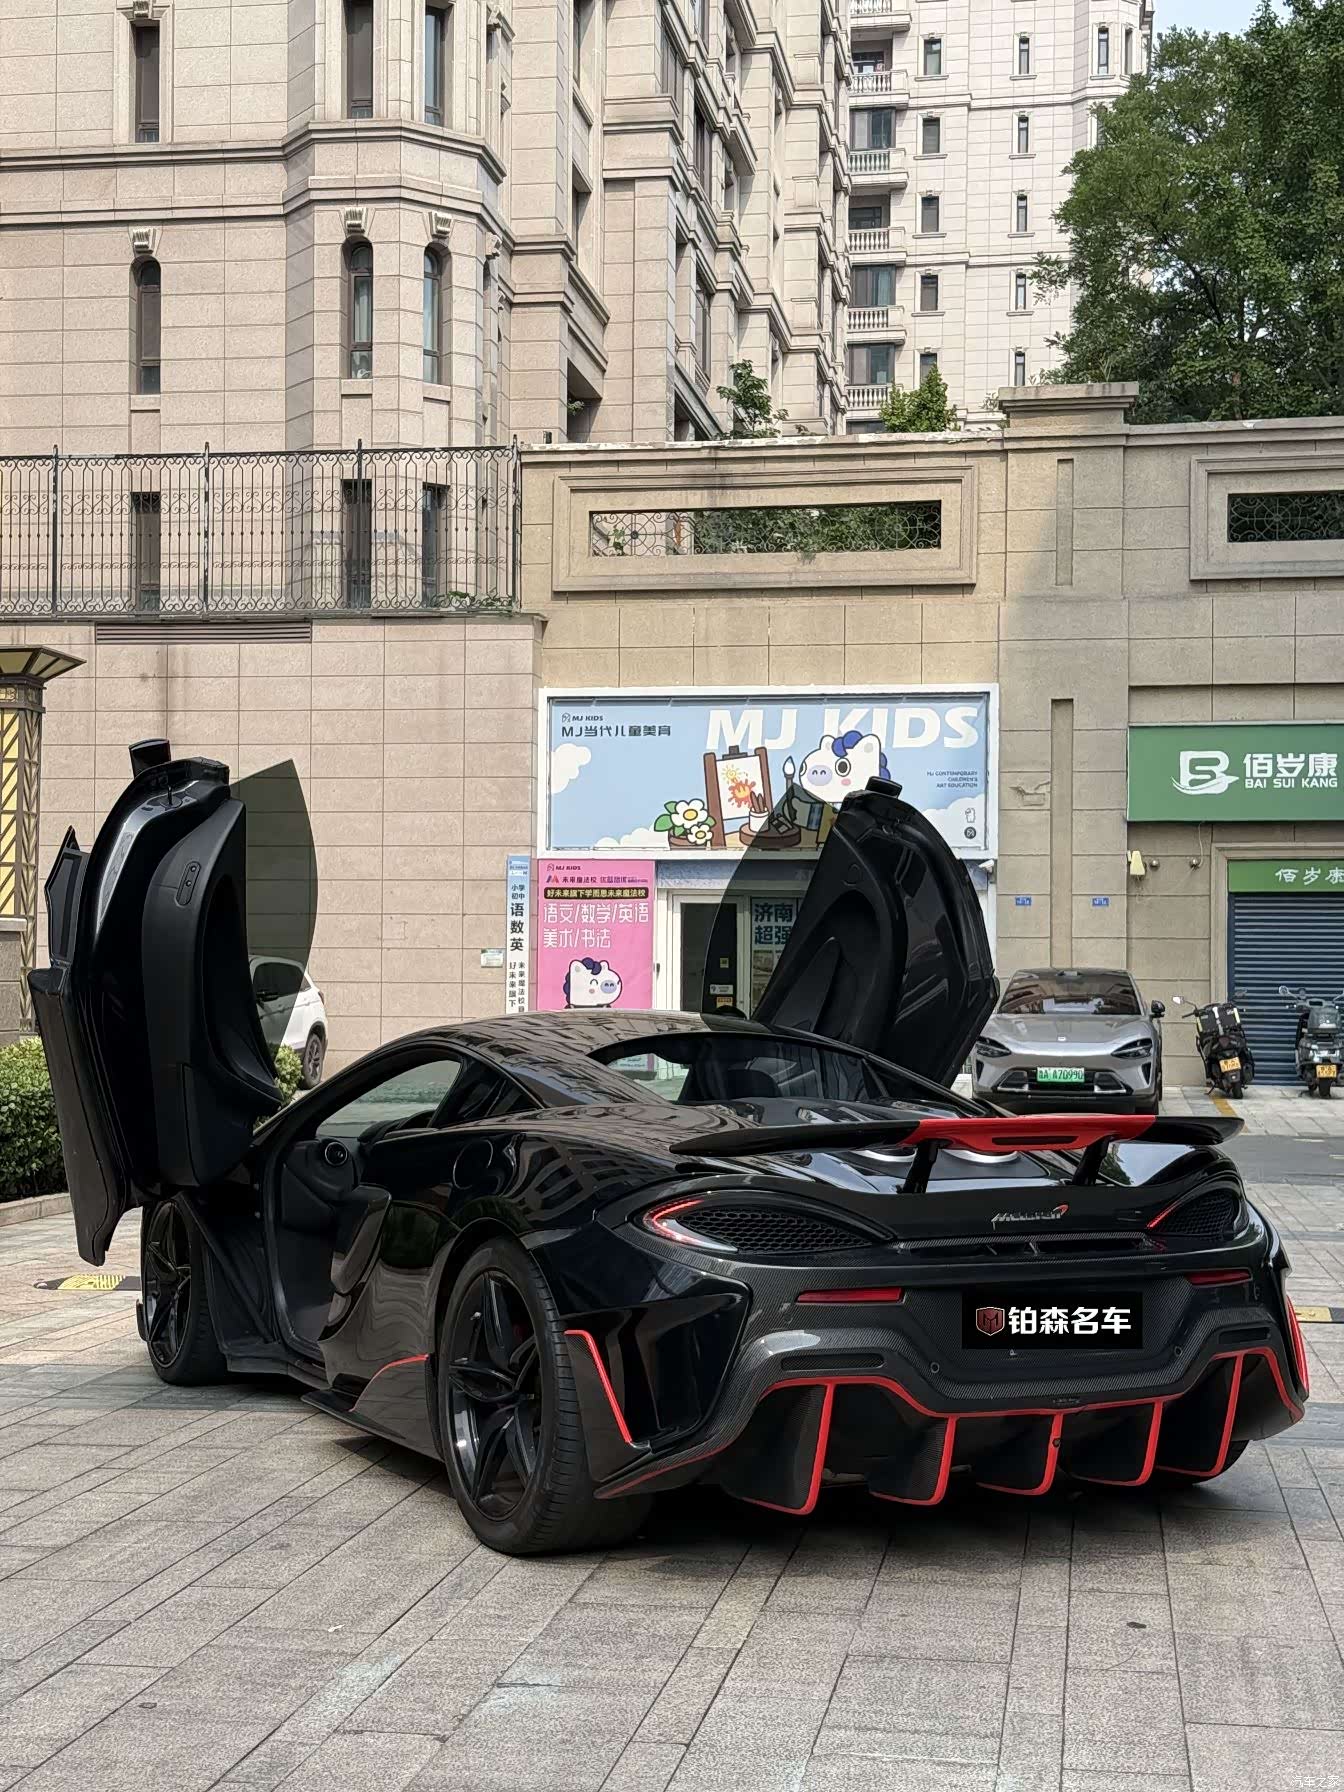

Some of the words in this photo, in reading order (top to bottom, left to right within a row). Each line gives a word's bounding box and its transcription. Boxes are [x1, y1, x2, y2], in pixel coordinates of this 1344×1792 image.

[561, 725, 671, 737] MJ当代儿童美育
[705, 708, 798, 750] MJ
[822, 707, 980, 749] KIDS
[1243, 753, 1338, 778] 佰岁康
[1245, 778, 1267, 789] BAI
[1273, 778, 1295, 789] SUI
[1302, 778, 1338, 788] KANG
[544, 902, 649, 924] 语文/数学/英语
[754, 902, 793, 922] 济南
[510, 902, 524, 952] 语数英
[754, 925, 793, 945] 超强
[544, 928, 611, 948] 美术/书法
